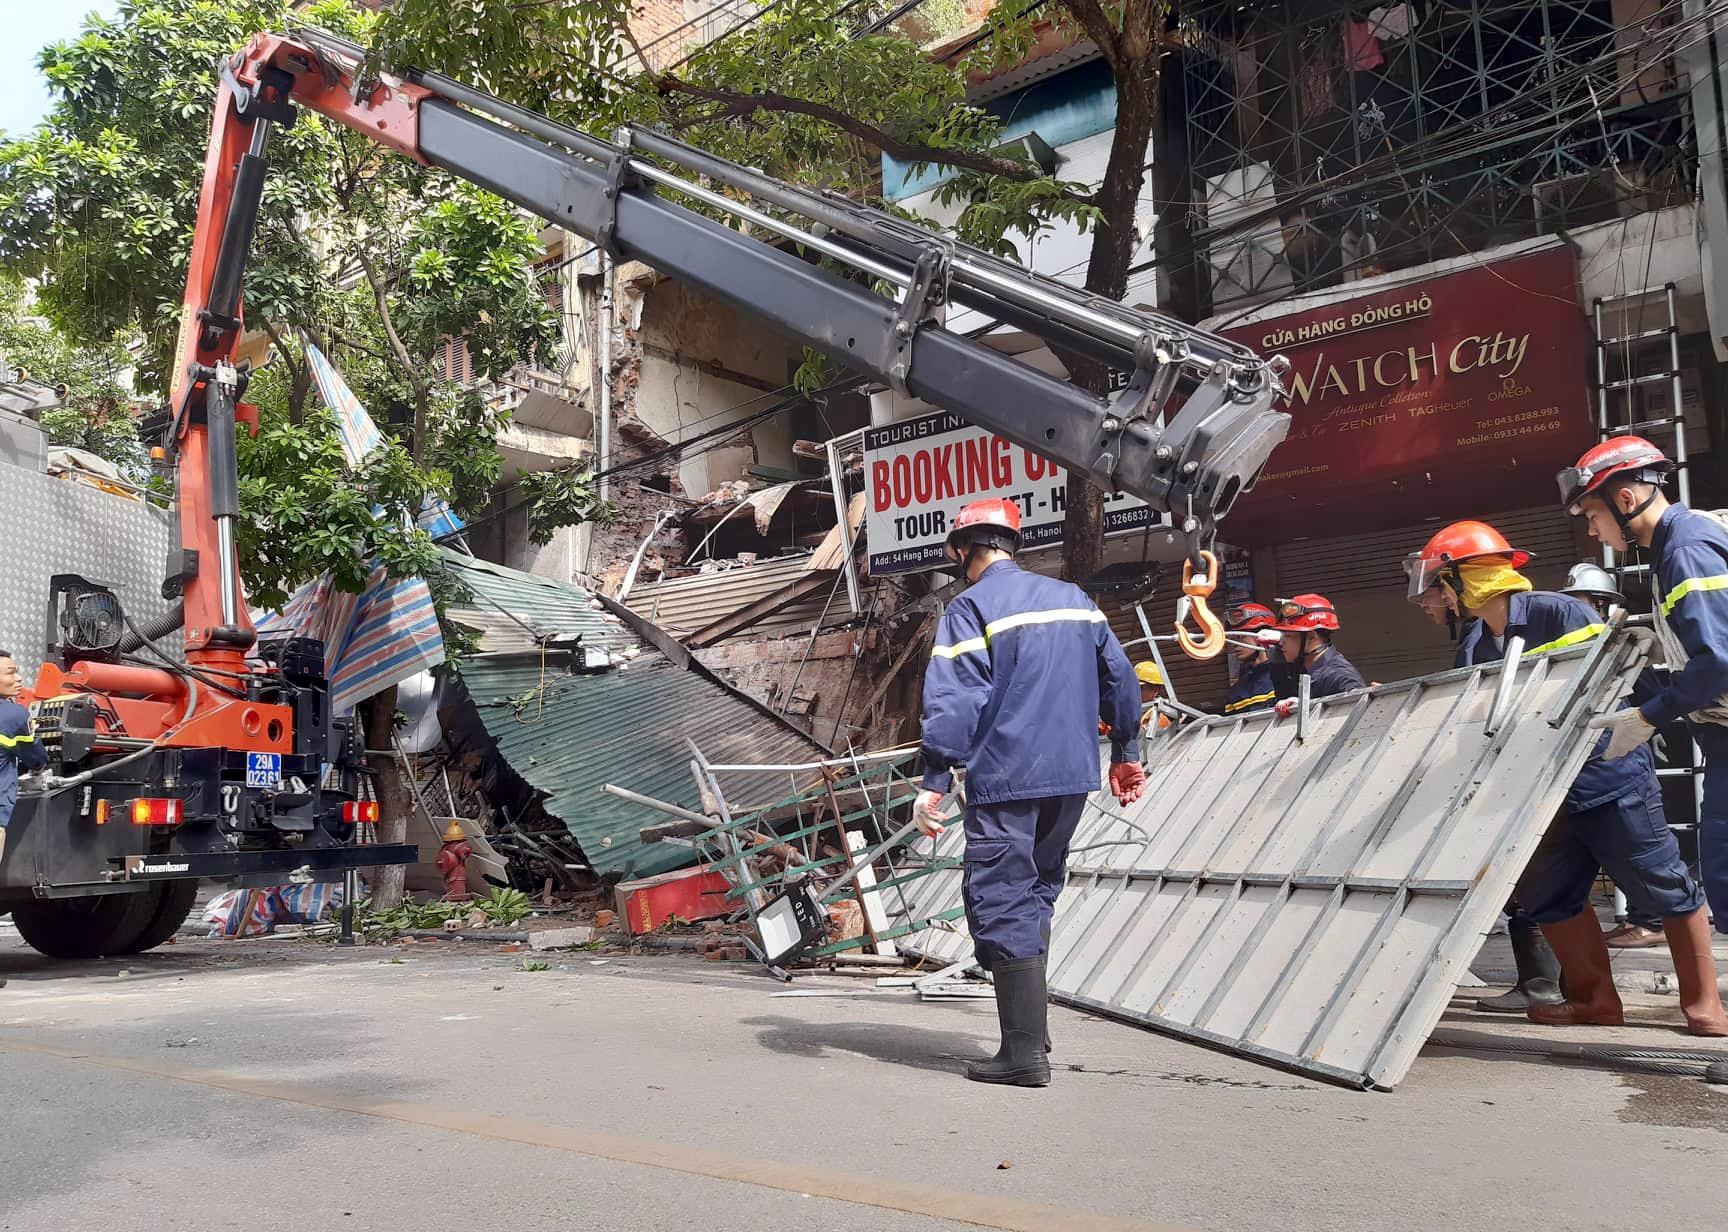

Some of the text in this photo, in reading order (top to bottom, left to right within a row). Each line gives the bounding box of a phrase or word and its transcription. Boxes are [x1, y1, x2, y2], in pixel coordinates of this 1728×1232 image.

[1262, 328, 1295, 348] CỬA
[1298, 317, 1346, 340] HÀNG
[1350, 304, 1401, 327] ĐỒNG
[1282, 331, 1530, 409] WATCH City
[1338, 412, 1397, 432] ZENITH
[1488, 386, 1532, 402] OMEGA
[870, 419, 937, 447] TOURIST
[1494, 429, 1518, 440] 0933
[1520, 425, 1532, 435] 44
[1534, 423, 1547, 432] 66
[1548, 420, 1561, 430] 69
[872, 434, 1013, 513] BOOKING
[894, 510, 946, 541] TOUR
[875, 555, 892, 566] Add:
[893, 554, 902, 563] 54
[903, 551, 922, 561] Hang
[923, 547, 943, 558] Bong
[1037, 525, 1062, 538] Hanoi
[255, 754, 273, 770] 29A
[145, 861, 189, 873] rosenbauer
[795, 901, 807, 923] LED
